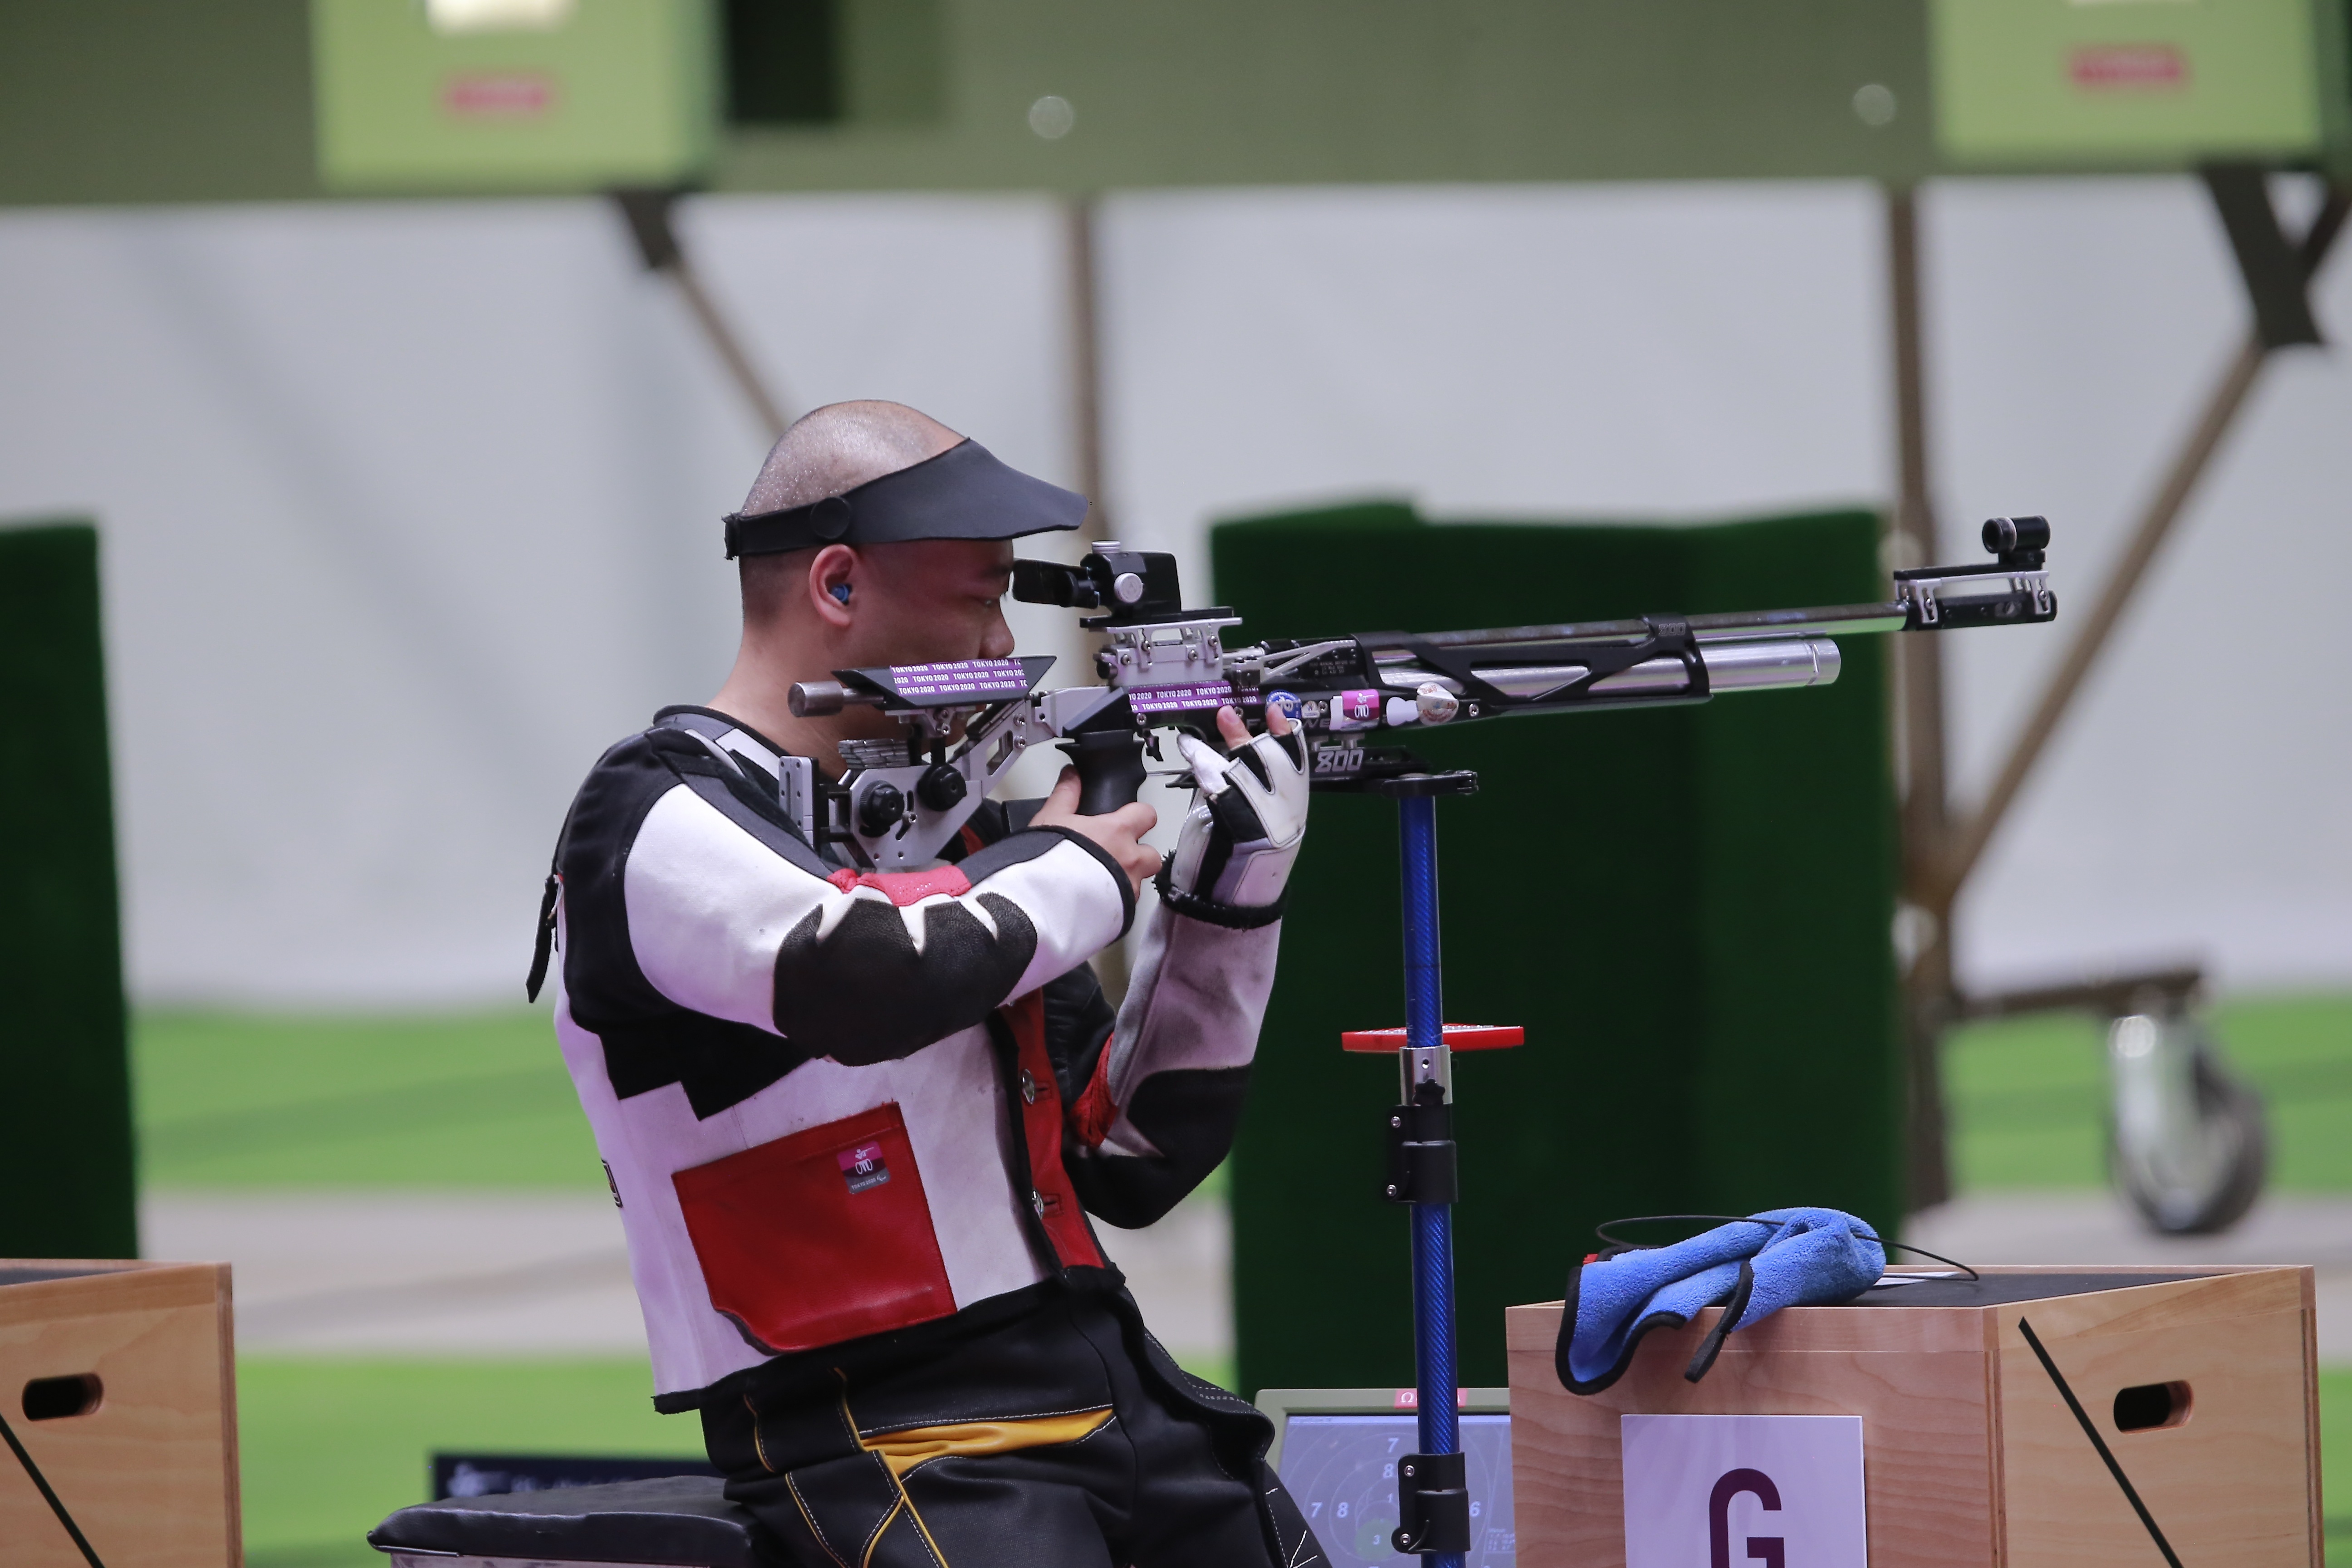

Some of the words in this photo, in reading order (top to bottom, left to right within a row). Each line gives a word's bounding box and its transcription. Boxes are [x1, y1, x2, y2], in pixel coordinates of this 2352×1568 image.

[1314, 749, 1363, 773] 800
[1388, 1437, 1399, 1453] 7
[1384, 1463, 1394, 1478] 8
[1311, 1502, 1323, 1518] 7
[1337, 1502, 1348, 1518] 8
[1709, 1468, 1785, 1568] G
